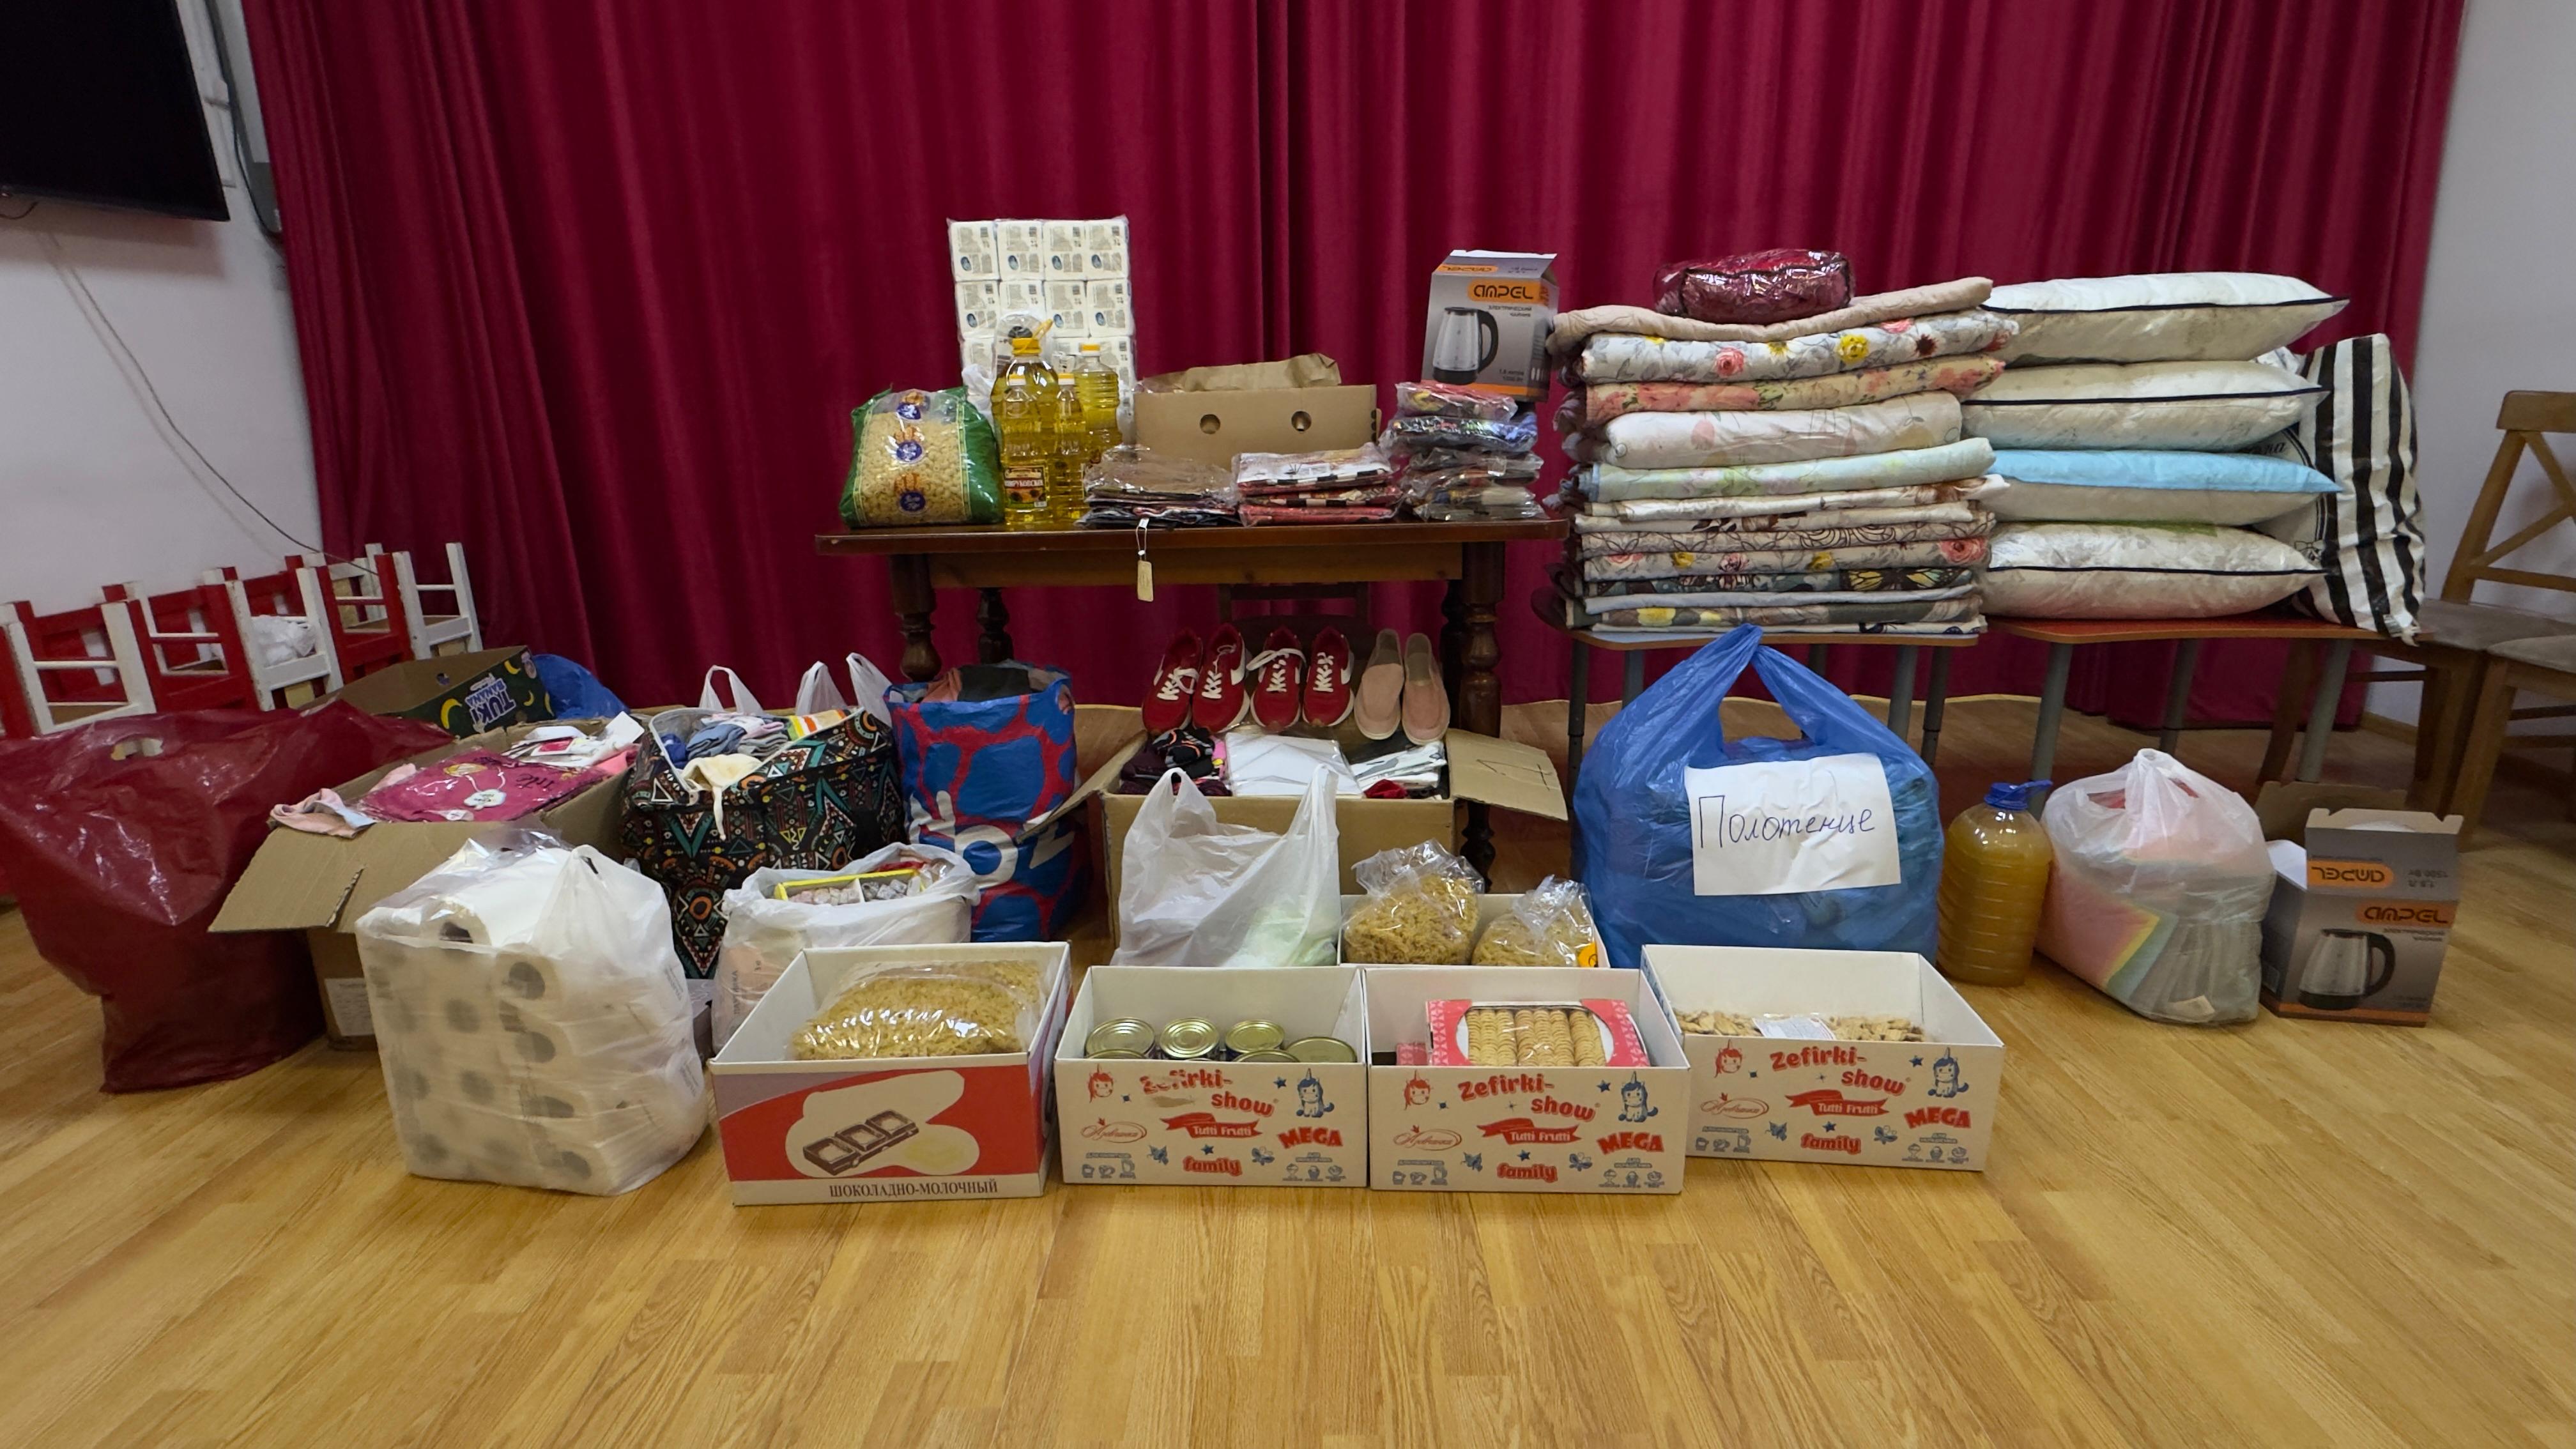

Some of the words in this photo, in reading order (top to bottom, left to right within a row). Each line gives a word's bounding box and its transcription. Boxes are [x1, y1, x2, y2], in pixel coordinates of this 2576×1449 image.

[1473, 285, 1533, 299] AMPEL
[467, 678, 506, 707] BANANA
[471, 689, 515, 724] TUKI
[1698, 794, 1876, 849] Полотенце
[2364, 906, 2449, 924] AMPEL
[1841, 1068, 1906, 1096] show
[1211, 1091, 1275, 1117] show
[1531, 1095, 1595, 1123] show
[1817, 1103, 1843, 1114] Tutti
[1846, 1104, 1879, 1116] Frutti
[1903, 1107, 1972, 1130] MEGA
[1193, 1126, 1218, 1137] Tutti
[1220, 1126, 1252, 1137] Frutti
[1277, 1126, 1344, 1149] MEGA
[1510, 1130, 1535, 1142] Tutti
[1538, 1131, 1571, 1142] Frutti
[1596, 1131, 1665, 1155] MEGA
[1800, 1133, 1862, 1155] family
[1183, 1156, 1243, 1176] family
[1496, 1162, 1558, 1183] family
[829, 1177, 999, 1198] ШОКОЛАДНО-МОЛОЧНЫЙ
